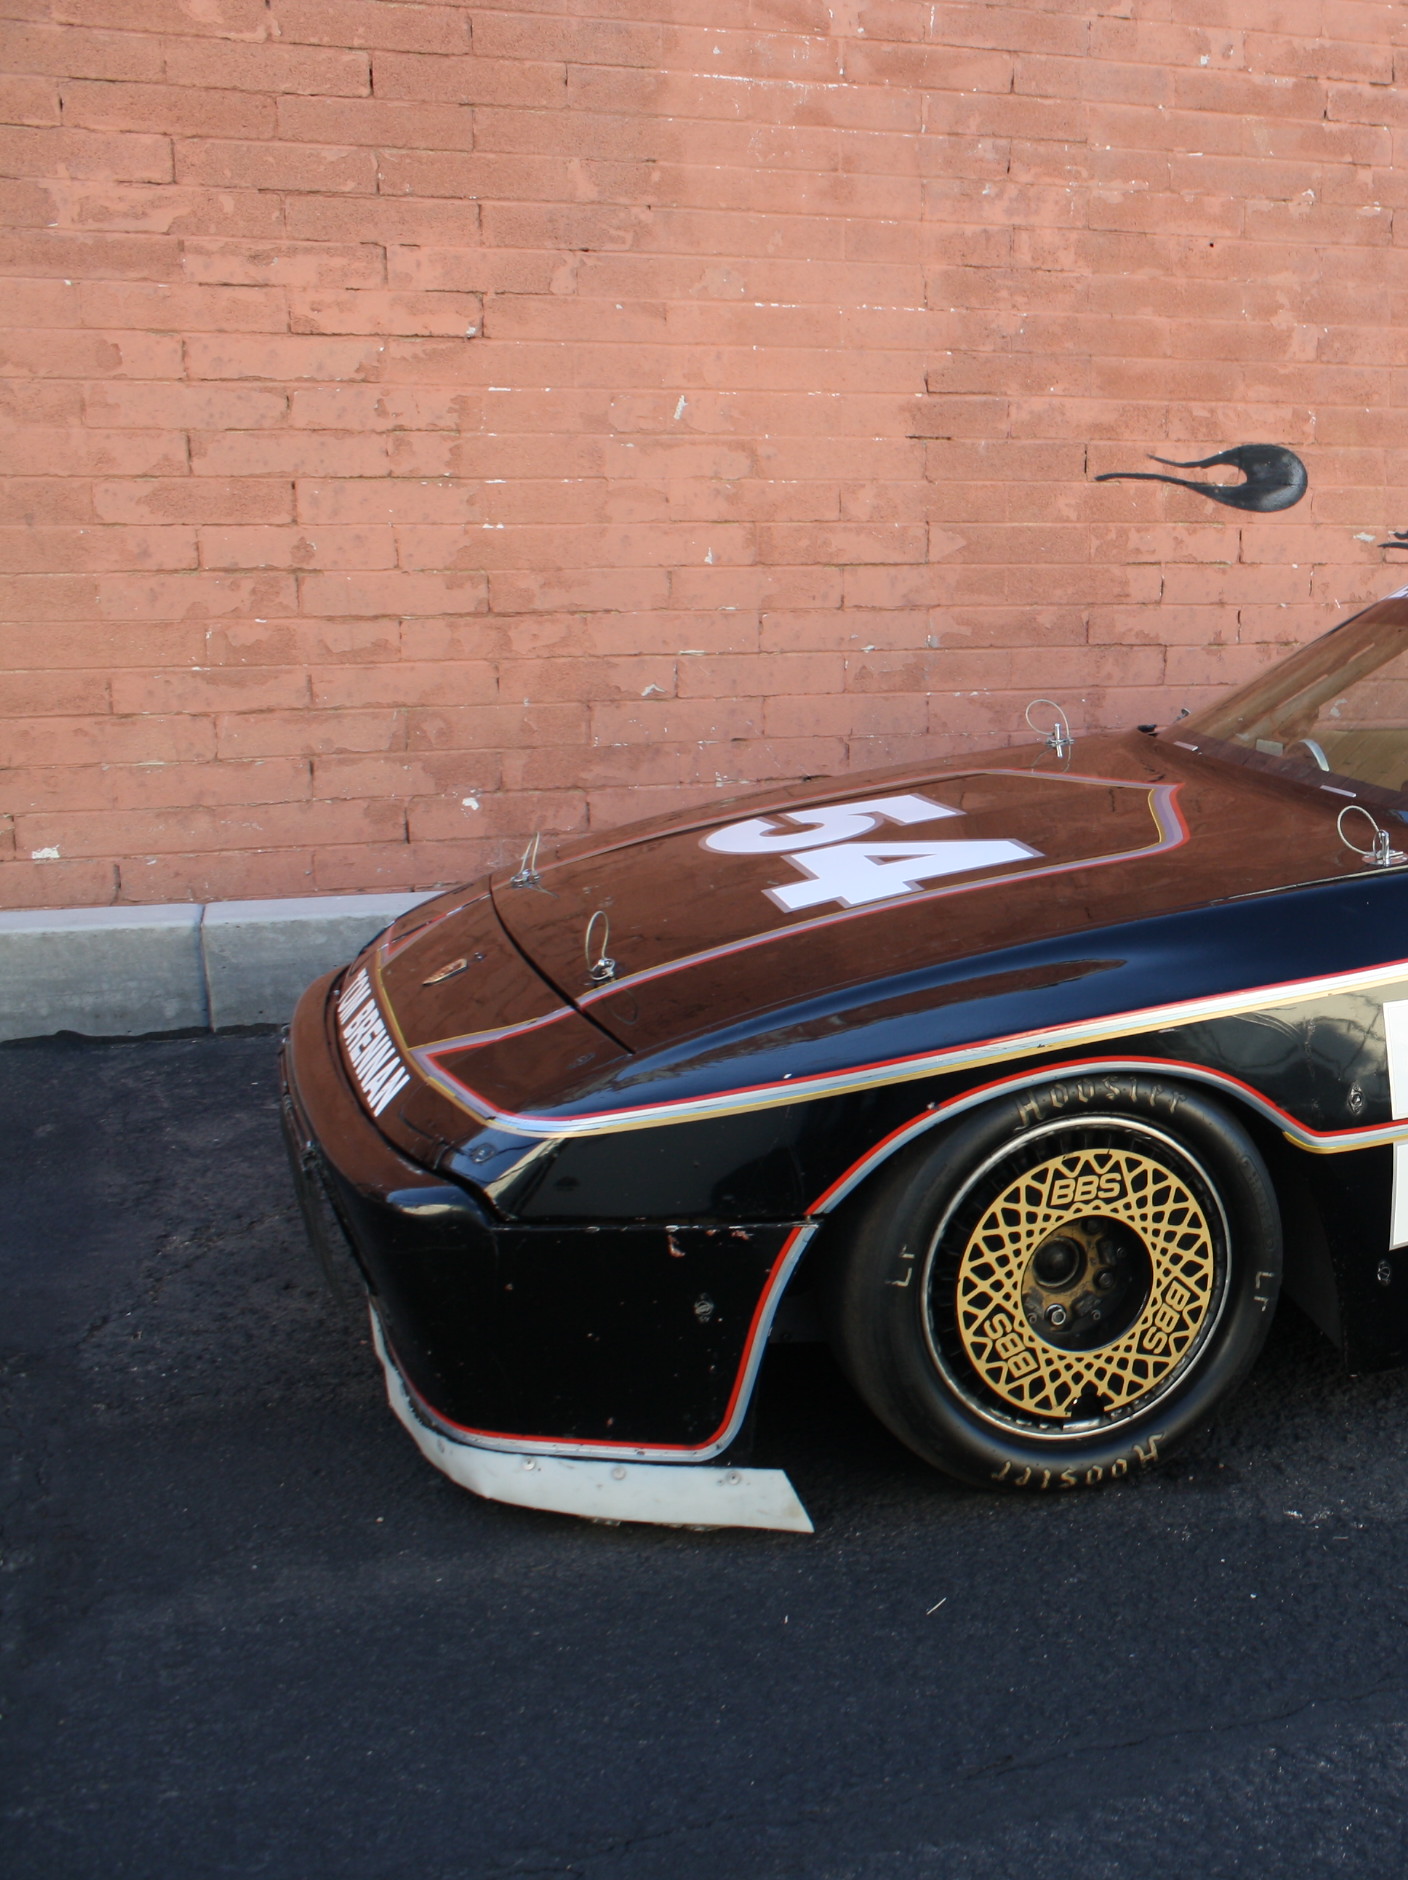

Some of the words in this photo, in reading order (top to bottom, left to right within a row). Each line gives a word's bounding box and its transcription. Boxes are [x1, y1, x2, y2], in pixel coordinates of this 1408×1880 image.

[698, 793, 1046, 913] 54
[342, 998, 411, 1118] BRENNAN
[1051, 1172, 1123, 1207] BBS
[982, 1311, 1038, 1379] BBS
[1143, 1279, 1191, 1356] BBS
